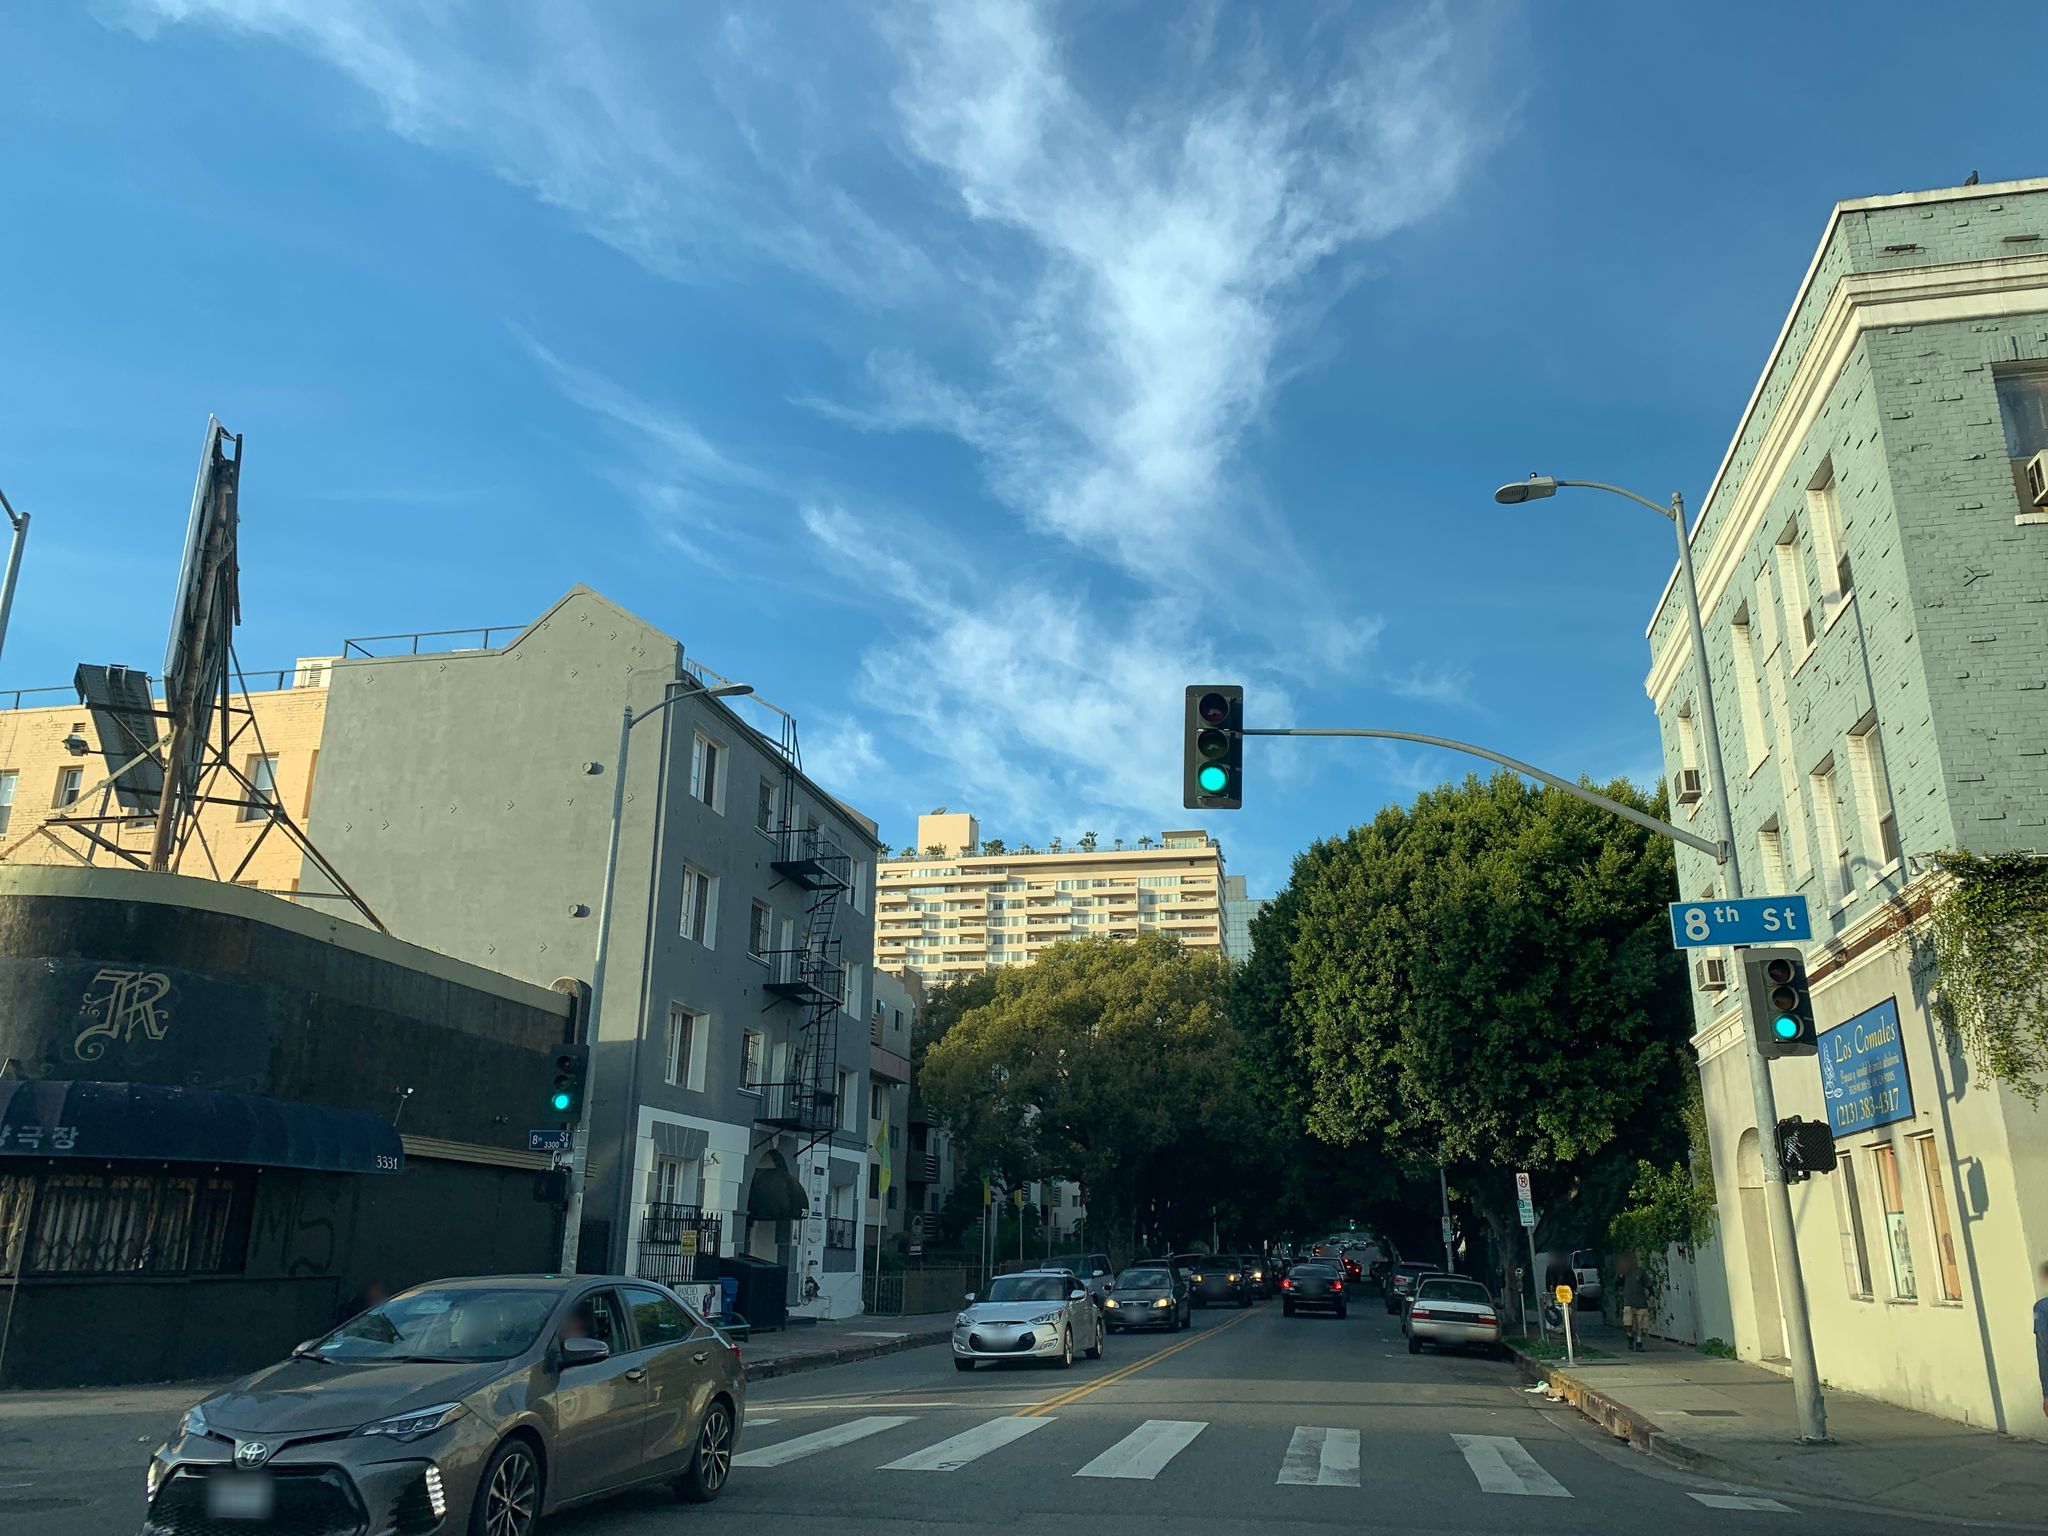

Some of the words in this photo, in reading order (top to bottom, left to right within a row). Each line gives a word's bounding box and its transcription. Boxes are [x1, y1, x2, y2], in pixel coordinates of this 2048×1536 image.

[1684, 905, 1740, 941] 8th
[1762, 907, 1797, 932] St
[1835, 1034, 1852, 1063] Los
[1854, 1015, 1896, 1054] Comales
[1836, 1100, 1859, 1127] (213)
[1859, 1087, 1899, 1120] 383-4317
[544, 1141, 560, 1149] 3300
[560, 1132, 569, 1142] St
[376, 1155, 398, 1170] 3331
